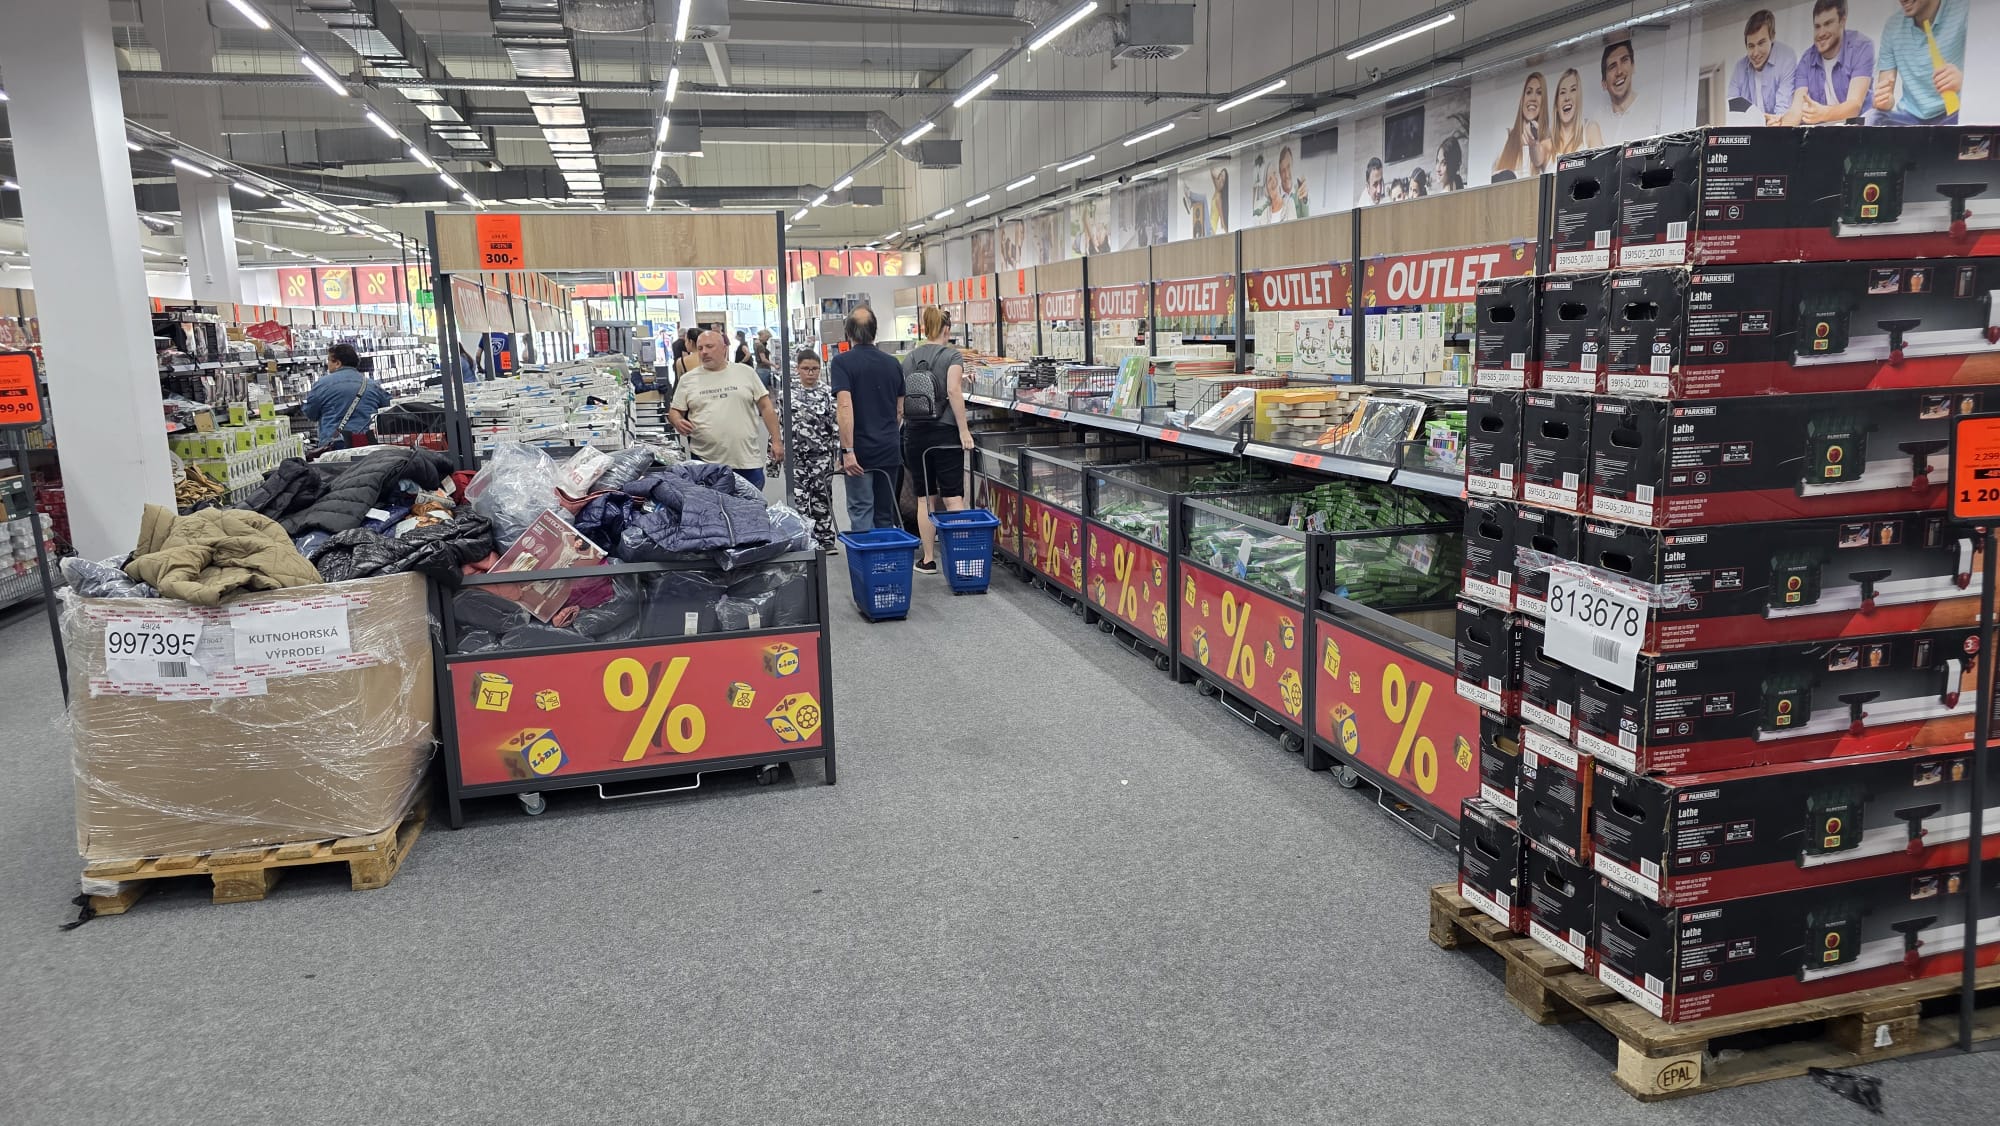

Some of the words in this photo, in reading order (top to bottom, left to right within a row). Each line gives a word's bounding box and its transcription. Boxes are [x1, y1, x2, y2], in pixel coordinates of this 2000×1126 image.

[1707, 153, 1728, 164] Lathe
[486, 253, 518, 265] 300,-
[1624, 249, 1665, 260] 391505_2201
[1387, 254, 1500, 300] OUTLET
[1263, 271, 1333, 307] OUTLET
[1551, 282, 1571, 290] PARKSIDE
[1618, 279, 1640, 288] PARKSIDE
[1166, 274, 1219, 313] OUTLET
[1690, 291, 1712, 301] Lathe
[1045, 293, 1075, 317] OUTLET
[1099, 286, 1138, 314] OUTLET
[969, 302, 991, 321] OUTLET
[1006, 299, 1030, 319] OUTLET
[1546, 374, 1580, 384] 391505_2201
[1611, 377, 1649, 390] 391505_2201
[1535, 398, 1554, 407] PARKSIDE
[1603, 404, 1625, 413] PARKSIDE
[1673, 424, 1694, 434] Lathe
[1527, 486, 1561, 501] 391505_2201
[1961, 490, 1971, 502] 1
[1596, 500, 1635, 514] 391505_2201
[1525, 512, 1543, 521] PARKSIDE
[1595, 526, 1615, 537] PARKSIDE
[1665, 551, 1686, 561] Lathe
[1551, 585, 1639, 636] 813678
[249, 626, 338, 644] KUTNOHORSKÁ
[109, 632, 196, 656] 997395
[265, 646, 325, 660] VÝPRODEJ
[1656, 678, 1676, 688] Lathe
[1603, 768, 1627, 784] PARKSIDE
[1689, 791, 1717, 800] PARKSIDE
[1678, 808, 1699, 818] Lathe
[1598, 857, 1640, 886] 391505_2201
[1607, 883, 1632, 899] PARKSIDE
[1692, 911, 1720, 920] PARKSIDE
[1682, 927, 1701, 938] Lathe
[1603, 968, 1644, 1000] 391505_2201
[1664, 1066, 1693, 1087] EPAL
